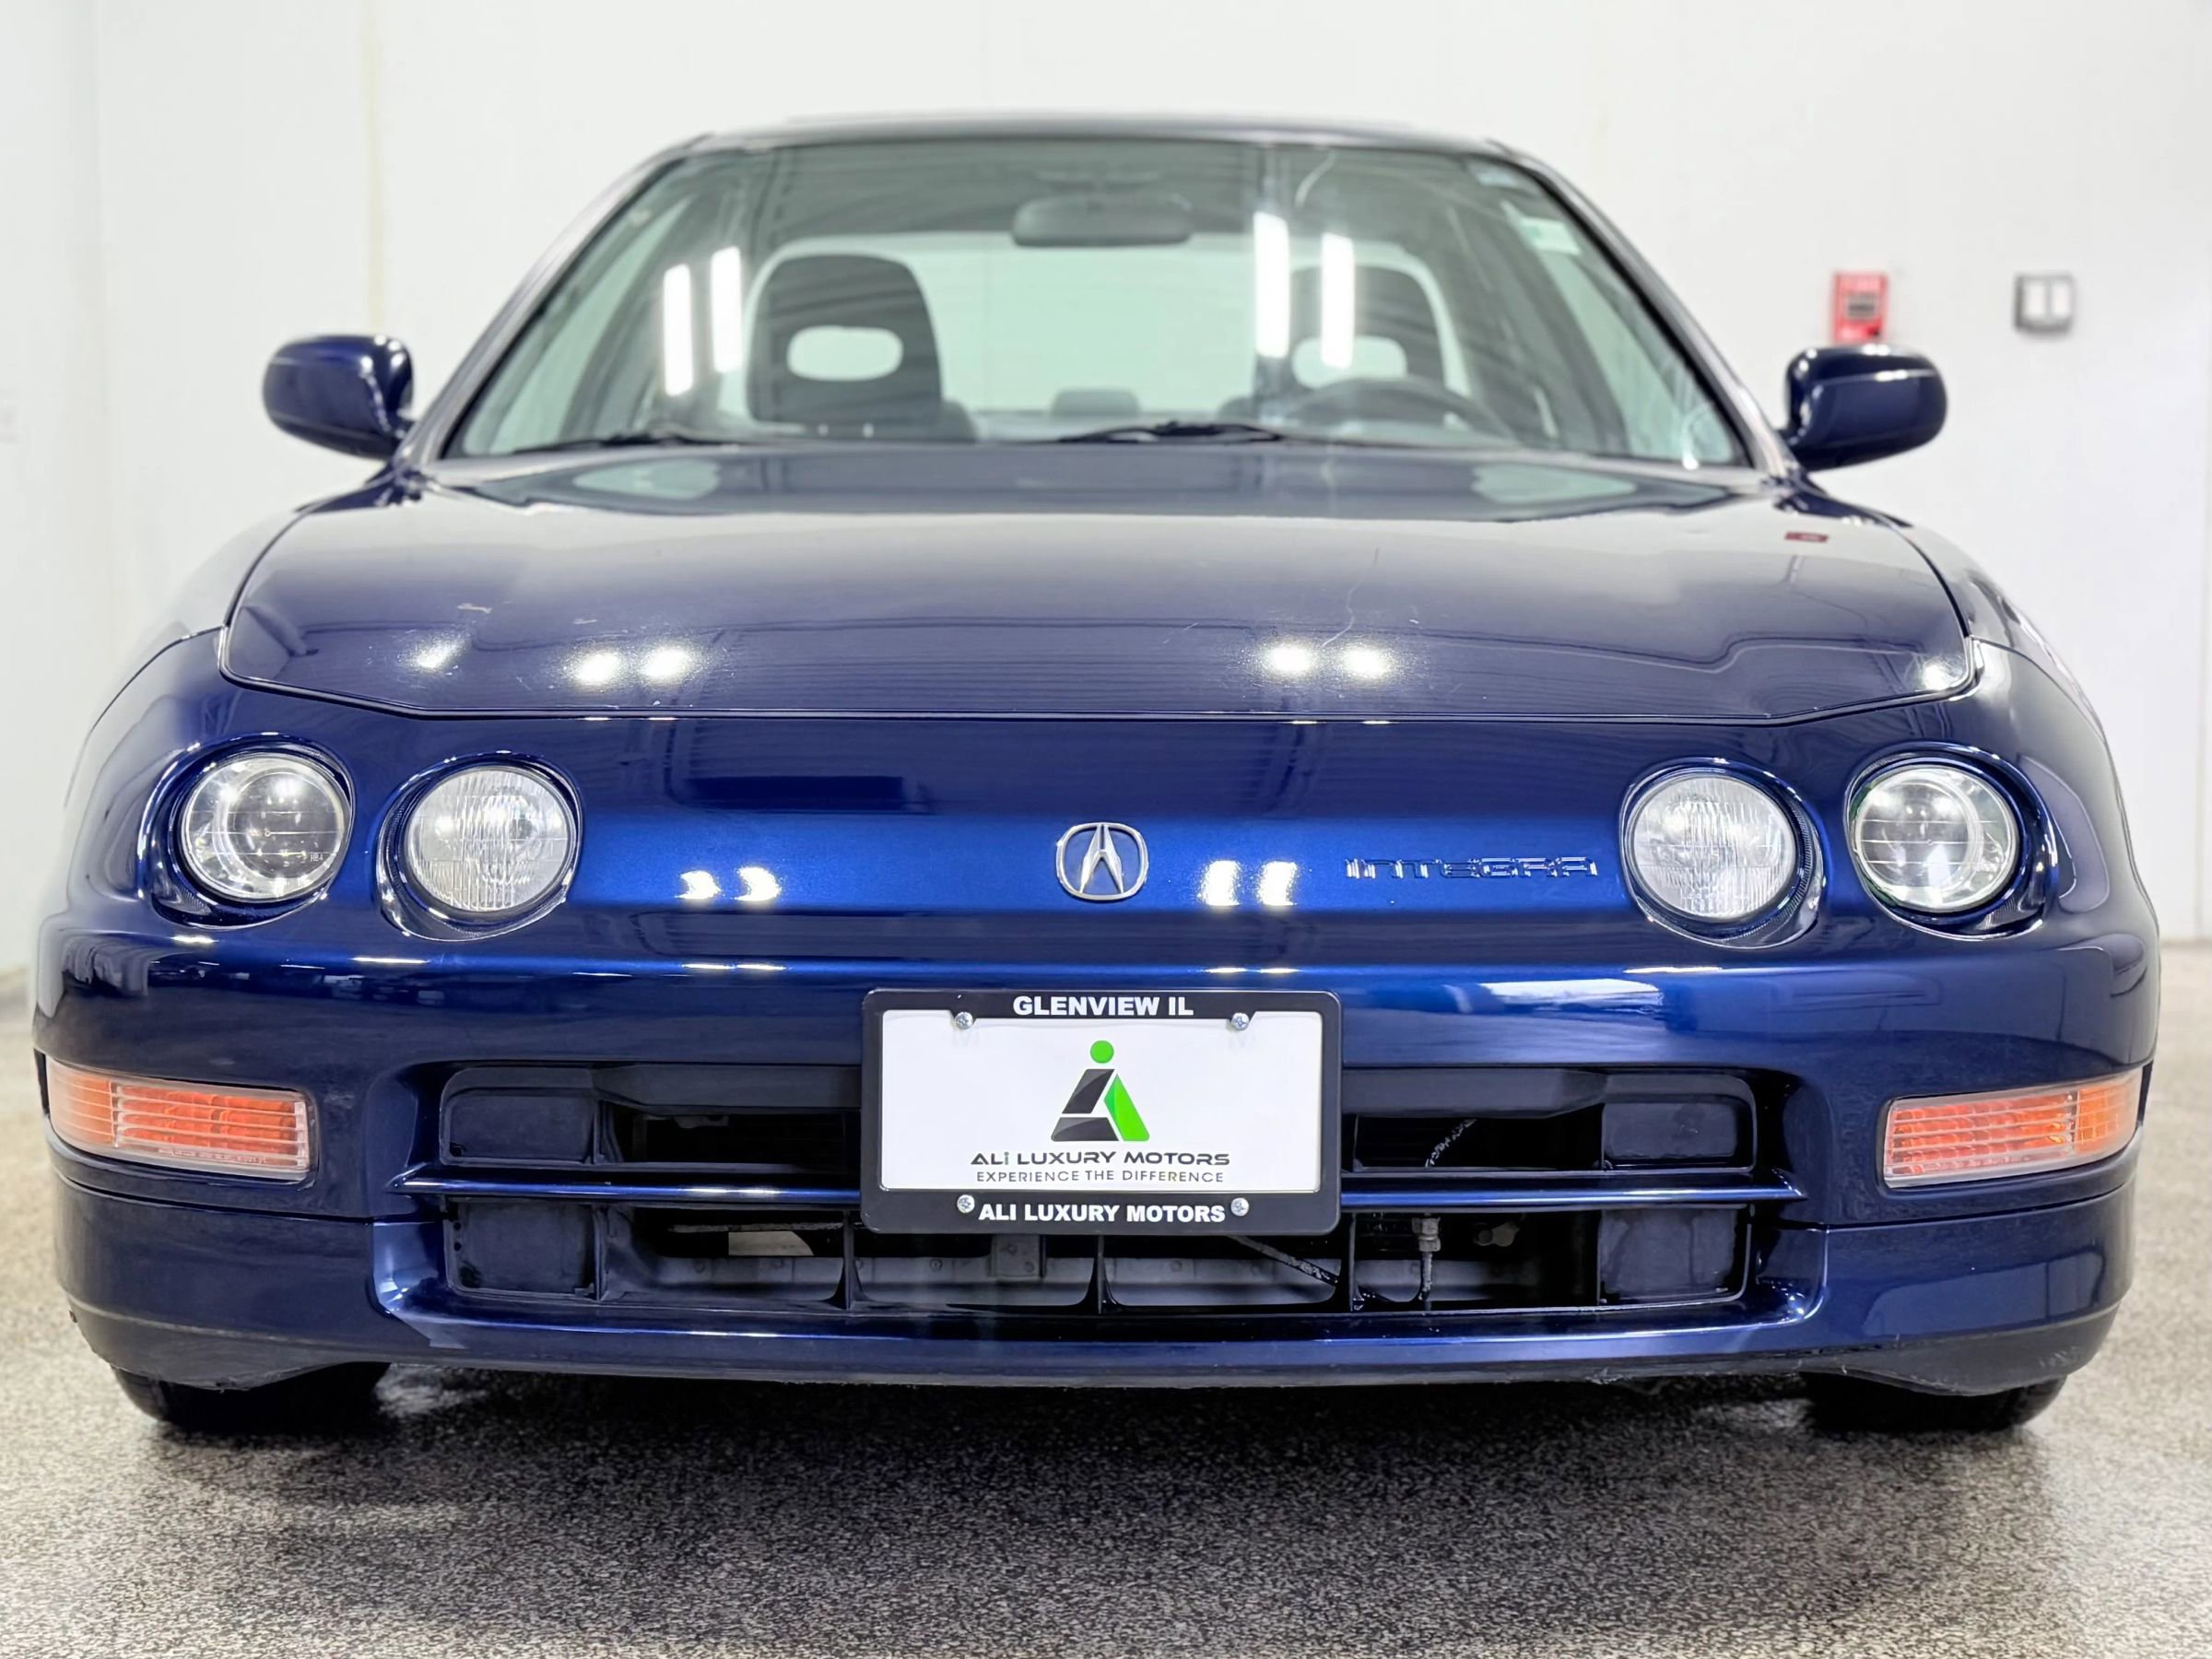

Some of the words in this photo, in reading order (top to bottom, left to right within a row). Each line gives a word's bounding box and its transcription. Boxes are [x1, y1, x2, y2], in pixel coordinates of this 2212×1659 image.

[1013, 995, 1160, 1016] GLENVIEW
[1168, 996, 1194, 1016] IL
[1017, 1151, 1117, 1165] LUXURY
[1124, 1151, 1230, 1166] MOTORS
[976, 1171, 1079, 1182] EXPERIENCE
[1085, 1170, 1114, 1181] THE
[1122, 1170, 1224, 1182] DIFFERENCE
[978, 1204, 1017, 1221] ALI
[1024, 1204, 1120, 1222] LUXURY
[1126, 1205, 1226, 1223] MOTORS
